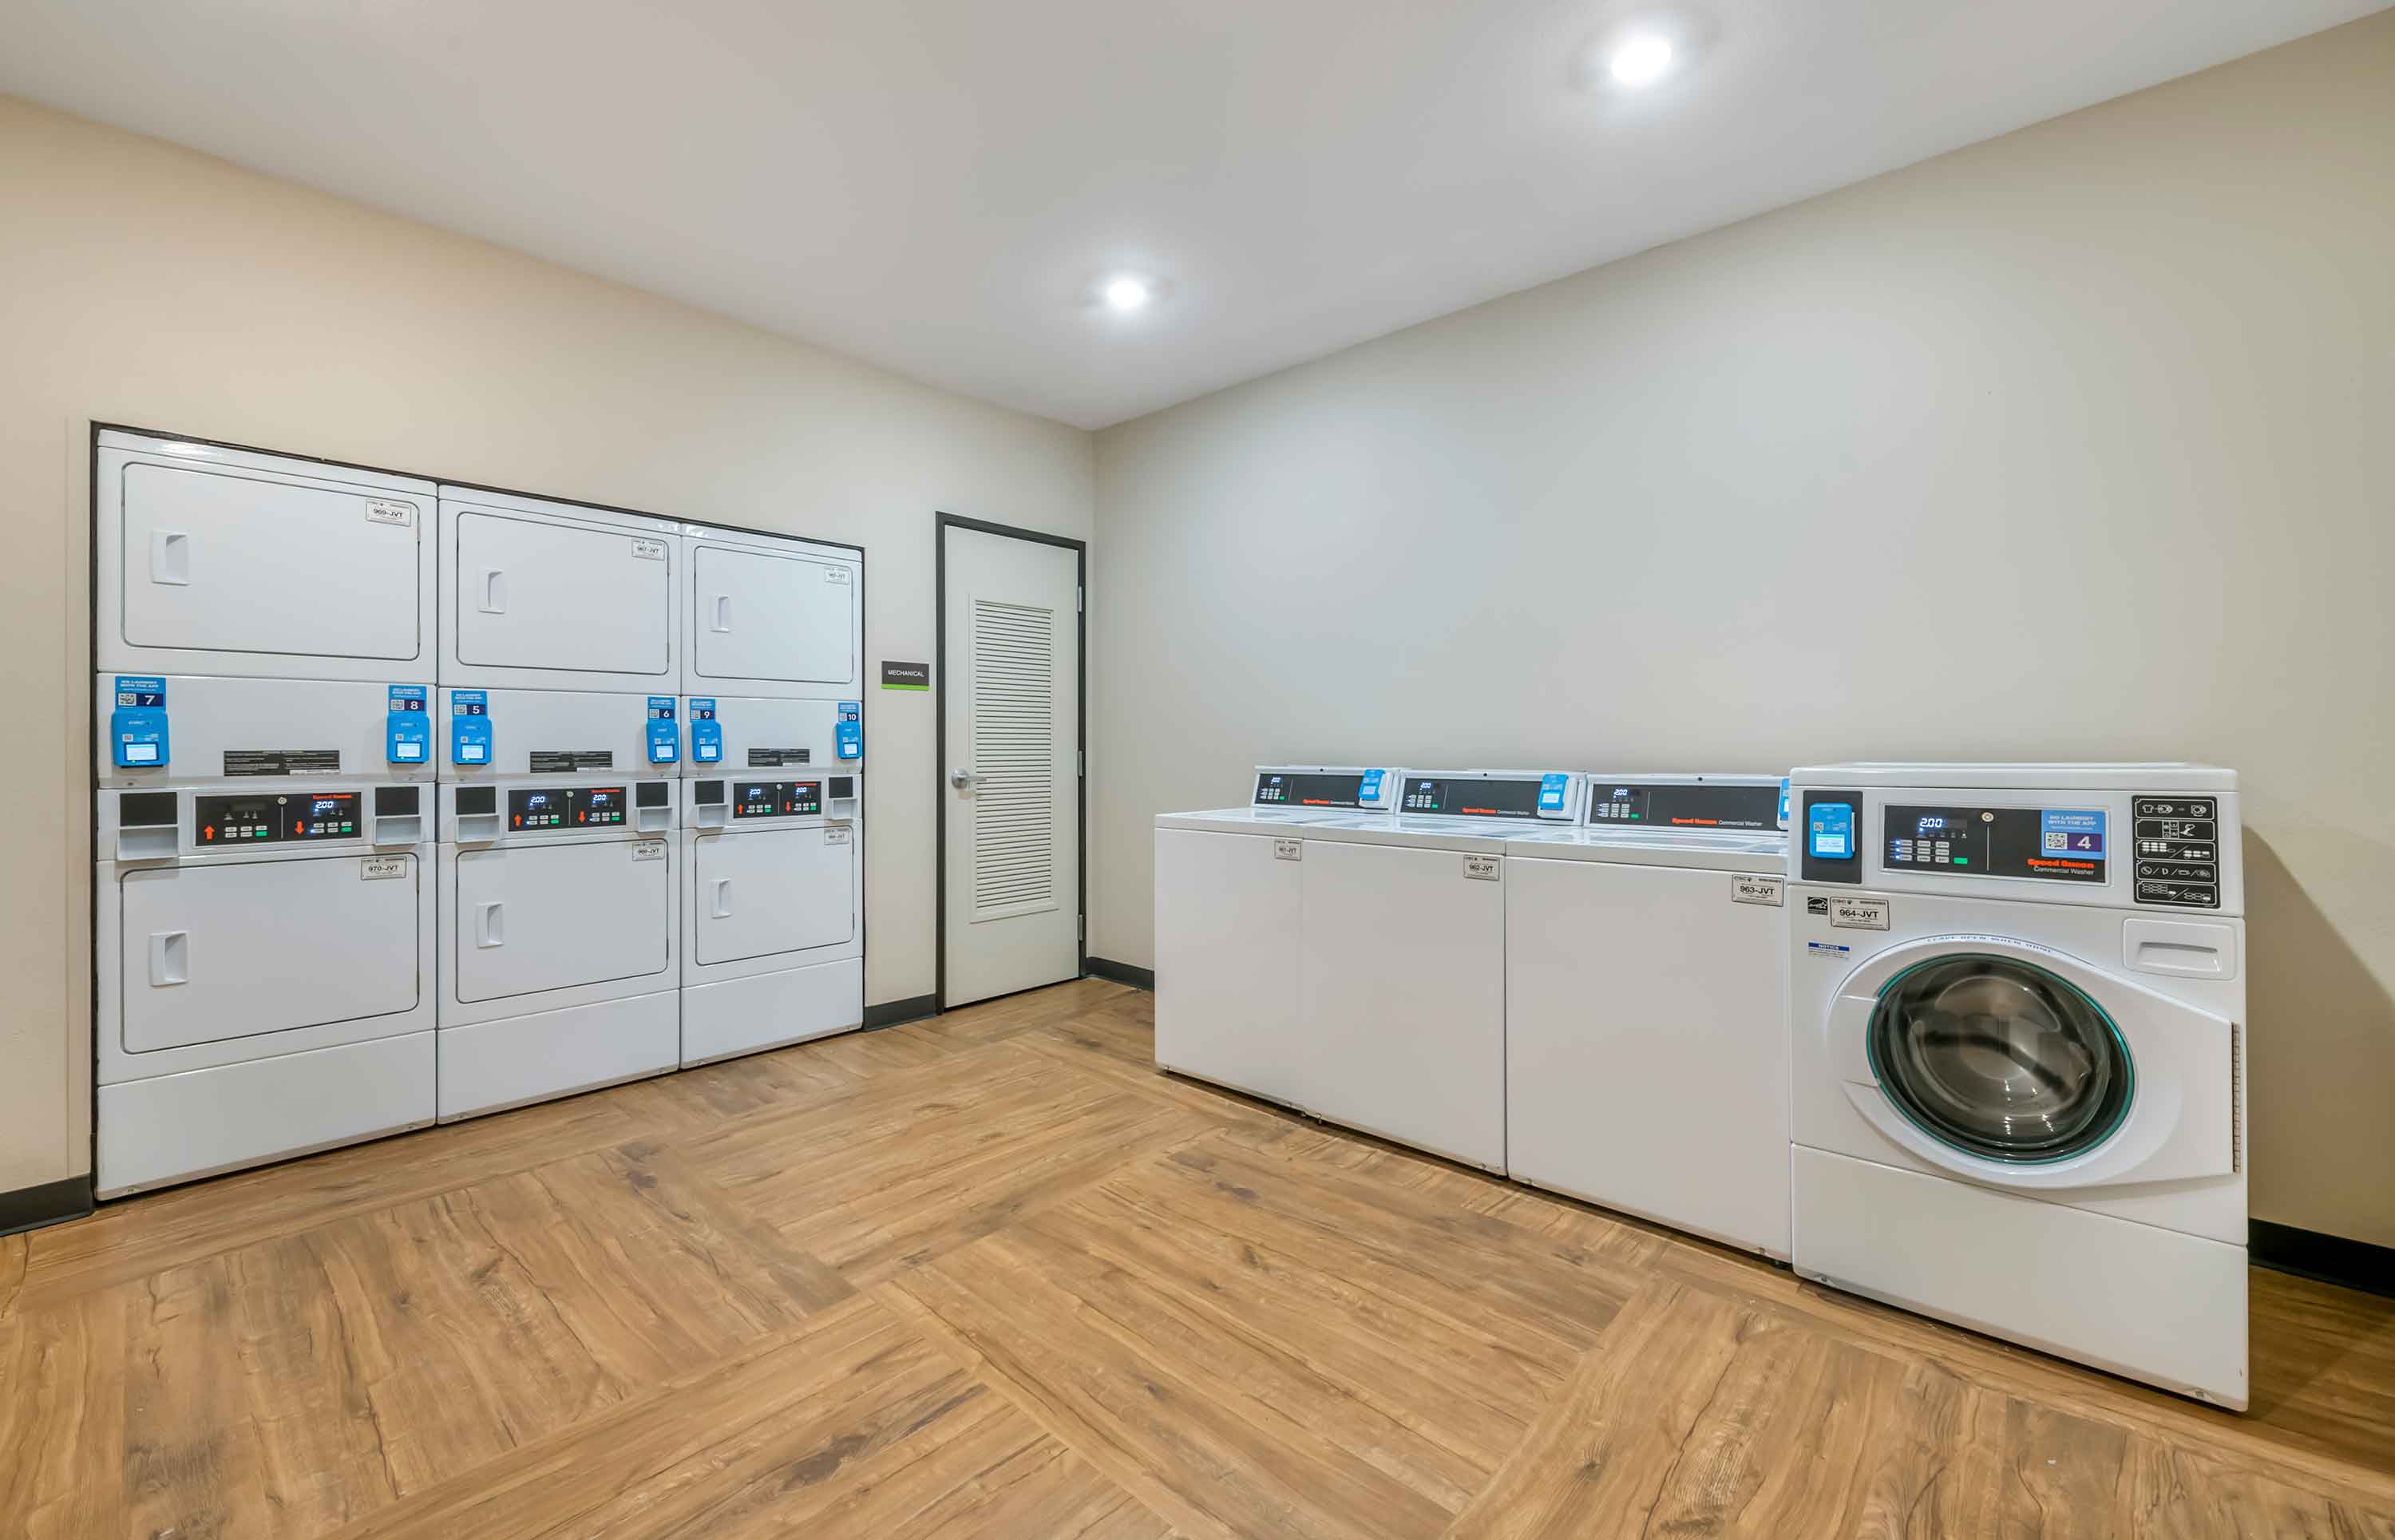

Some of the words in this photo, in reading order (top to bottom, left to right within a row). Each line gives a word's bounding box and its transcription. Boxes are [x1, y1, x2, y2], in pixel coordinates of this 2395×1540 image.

[144, 695, 156, 705] 7
[410, 701, 419, 710] 8
[473, 705, 481, 715] 5
[2077, 836, 2091, 849] 4
[2028, 858, 2060, 867] Speed
[2033, 865, 2070, 874] Commercial
[1740, 885, 1775, 895] 963-JVT
[1839, 909, 1879, 918] 964-JVT
